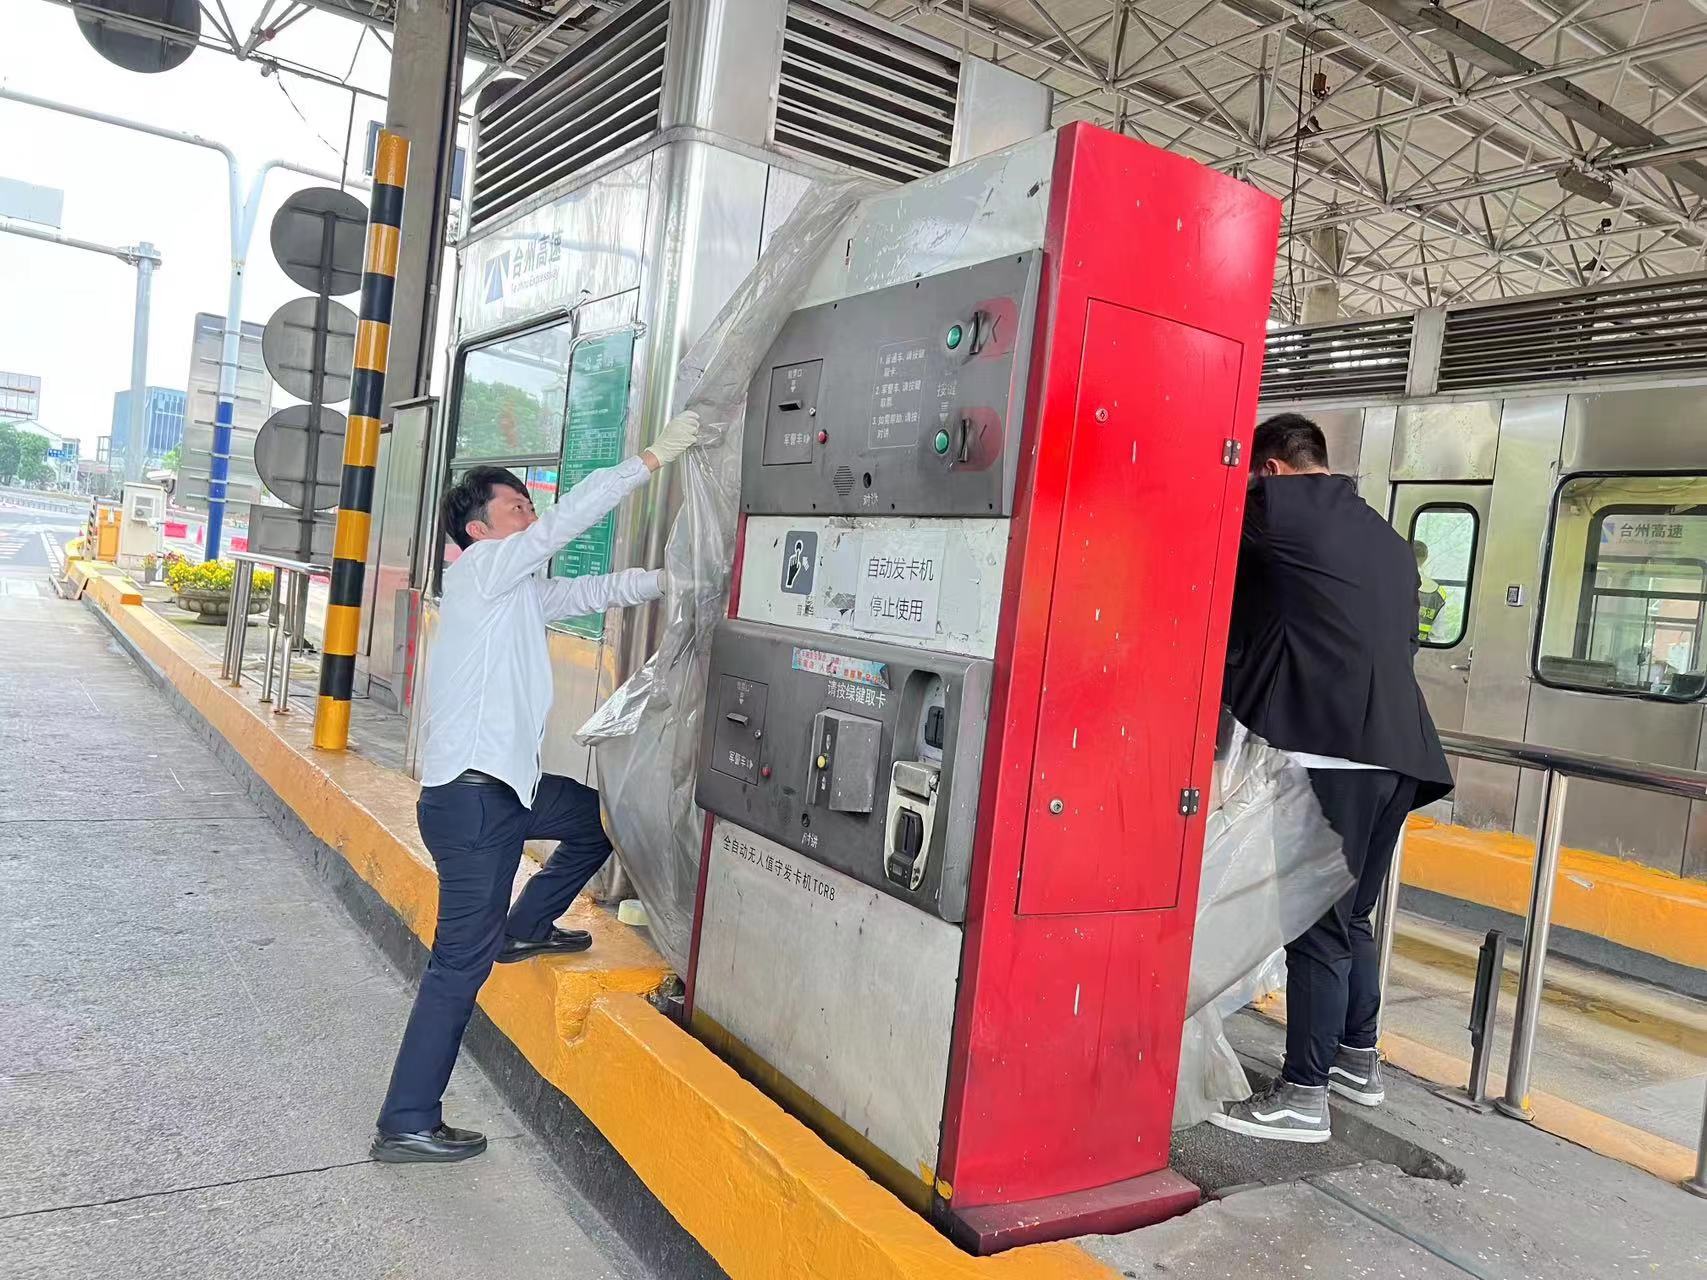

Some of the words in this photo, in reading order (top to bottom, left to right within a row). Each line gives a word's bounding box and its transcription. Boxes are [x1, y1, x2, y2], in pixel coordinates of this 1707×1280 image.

[1620, 523, 1684, 539] 台州高速
[868, 556, 935, 582] 自动发卡机
[870, 595, 924, 623] 停止使用
[826, 680, 887, 709] 请按绿键取卡
[801, 832, 819, 849] 对讲
